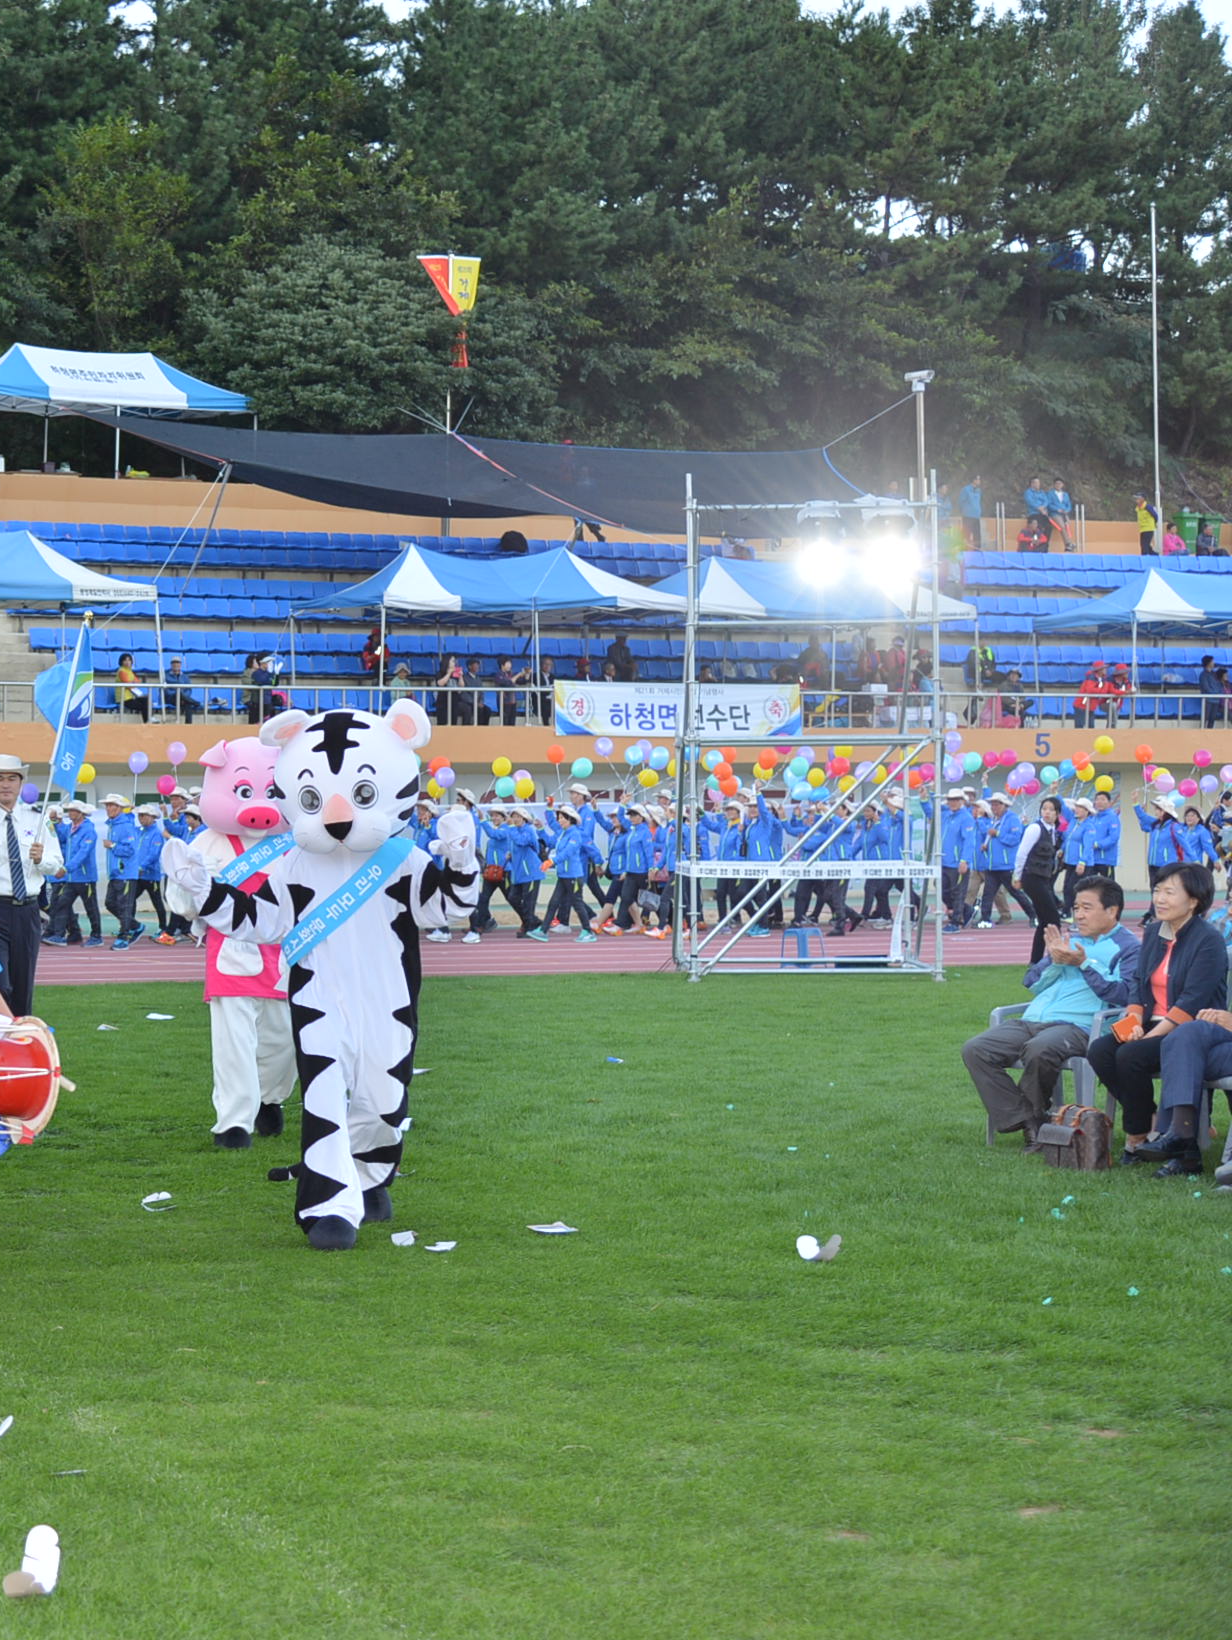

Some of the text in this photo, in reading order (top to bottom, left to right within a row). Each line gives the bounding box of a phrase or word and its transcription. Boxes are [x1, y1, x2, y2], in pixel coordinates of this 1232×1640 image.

[768, 700, 783, 718] 축
[1035, 733, 1051, 758] 5
[355, 864, 382, 896] 우리
[326, 891, 356, 920] 모두
